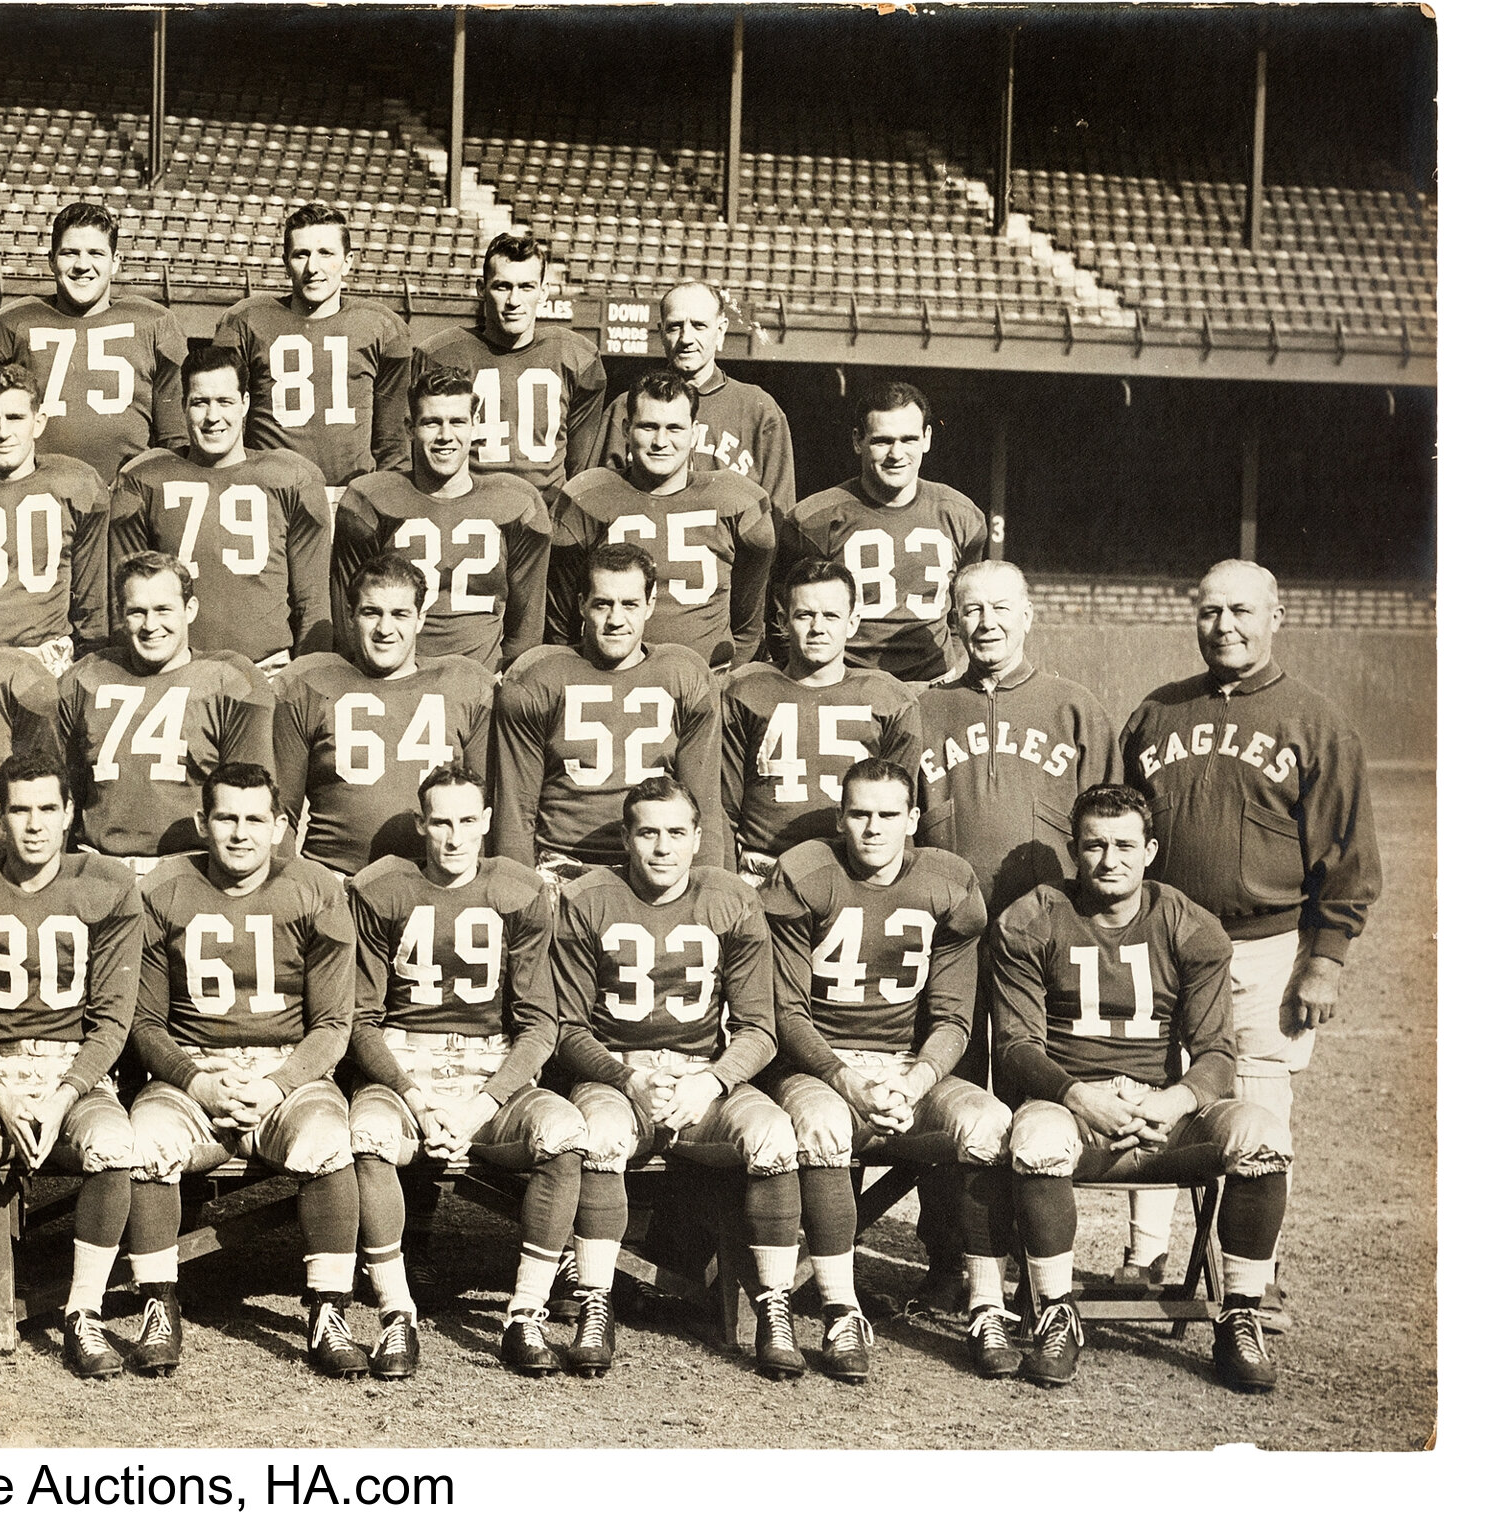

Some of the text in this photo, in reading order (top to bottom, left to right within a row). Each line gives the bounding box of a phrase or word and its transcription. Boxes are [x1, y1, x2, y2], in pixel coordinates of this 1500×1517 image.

[607, 303, 650, 322] DOWN
[607, 326, 648, 341] YARDS
[607, 340, 648, 354] TO GAIN
[29, 323, 137, 417] 75
[269, 335, 357, 427] 81
[471, 367, 562, 463] 40
[694, 423, 754, 476] LES
[162, 481, 269, 579] 79
[394, 518, 501, 613] 32
[844, 527, 953, 619] 83
[991, 515, 1005, 543] 3
[92, 683, 188, 782] 74
[334, 692, 453, 785] 64
[563, 685, 675, 786] 52
[756, 702, 872, 803] 45
[919, 721, 1078, 784] EAGLES
[1138, 723, 1298, 784] EAGLES
[185, 912, 286, 1015] 61
[394, 905, 504, 1005] 49
[601, 922, 720, 1023] 33
[812, 907, 937, 1004] 43
[1069, 943, 1162, 1040] 11
